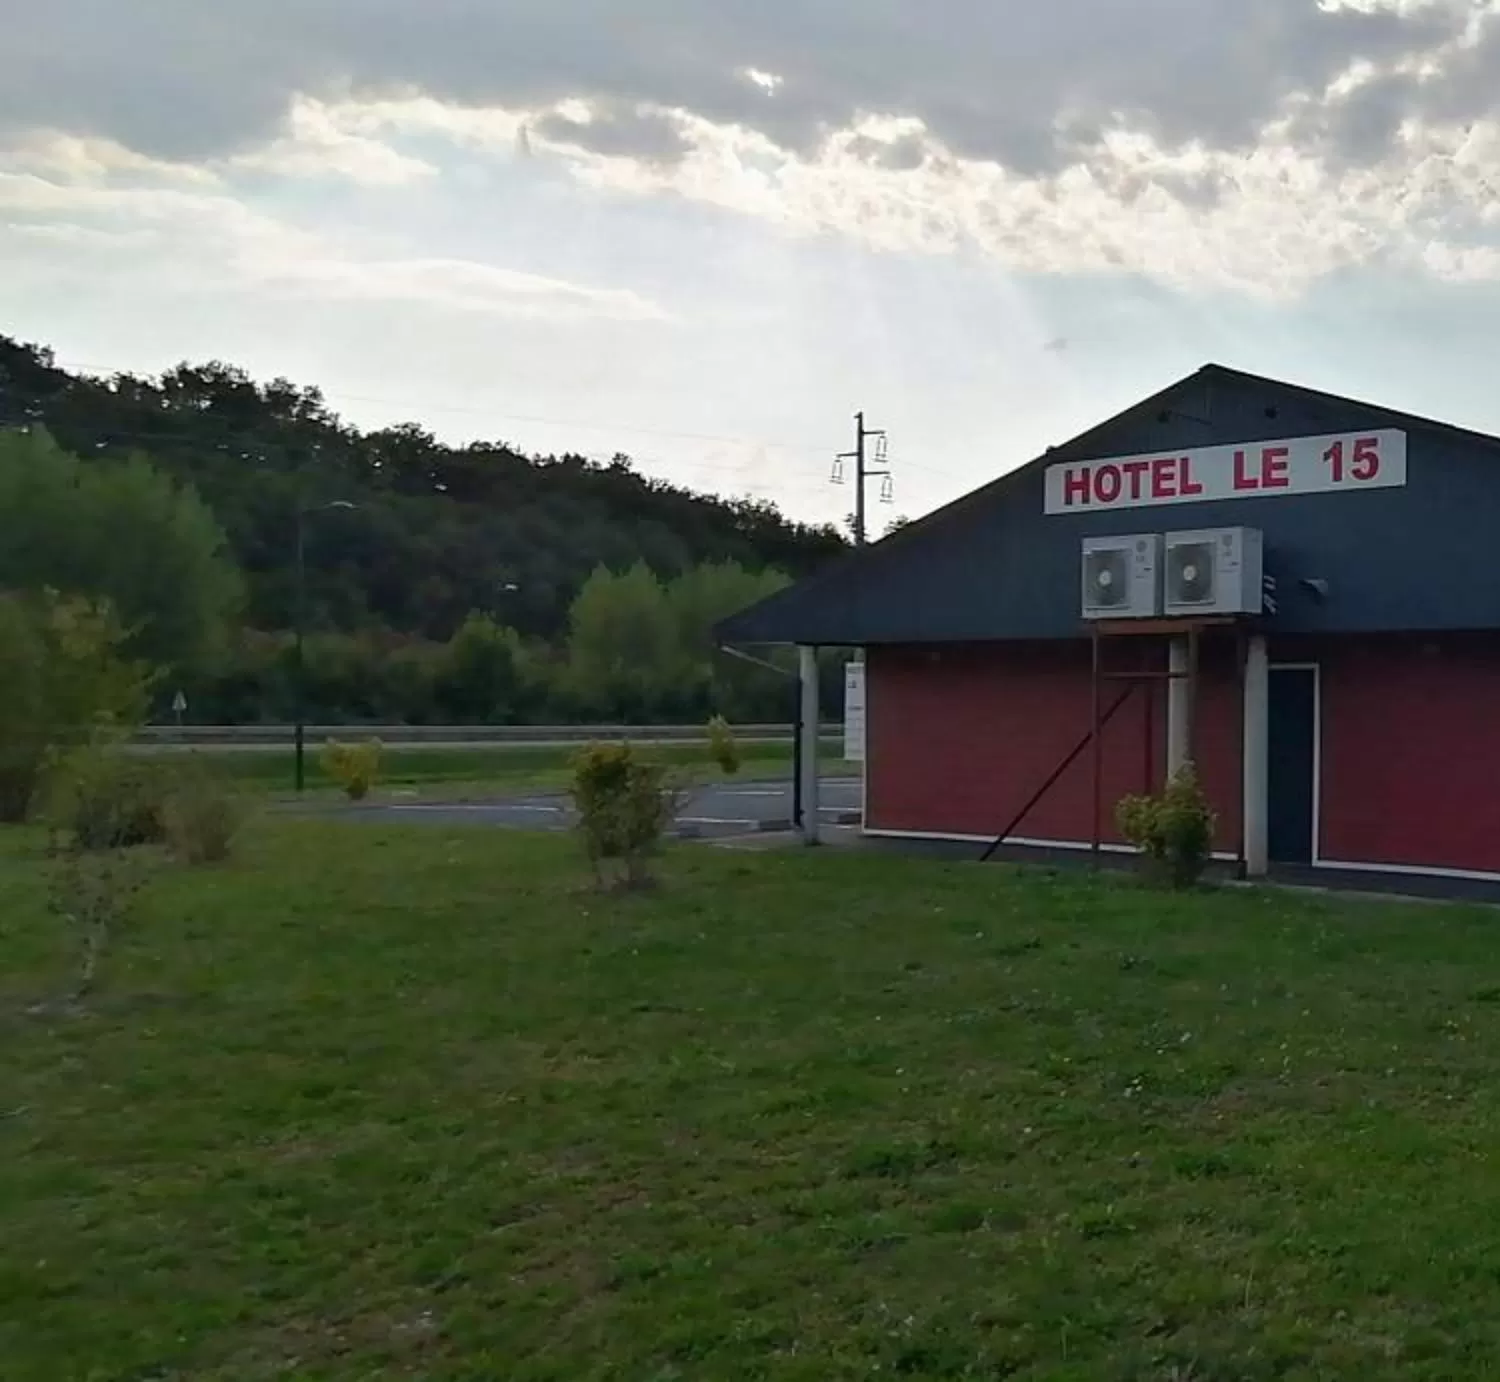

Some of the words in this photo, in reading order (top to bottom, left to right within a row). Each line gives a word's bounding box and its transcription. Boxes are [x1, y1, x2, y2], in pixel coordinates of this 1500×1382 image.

[1064, 457, 1202, 505] HOTEL
[1233, 448, 1289, 490] LE
[1323, 438, 1379, 482] 15
